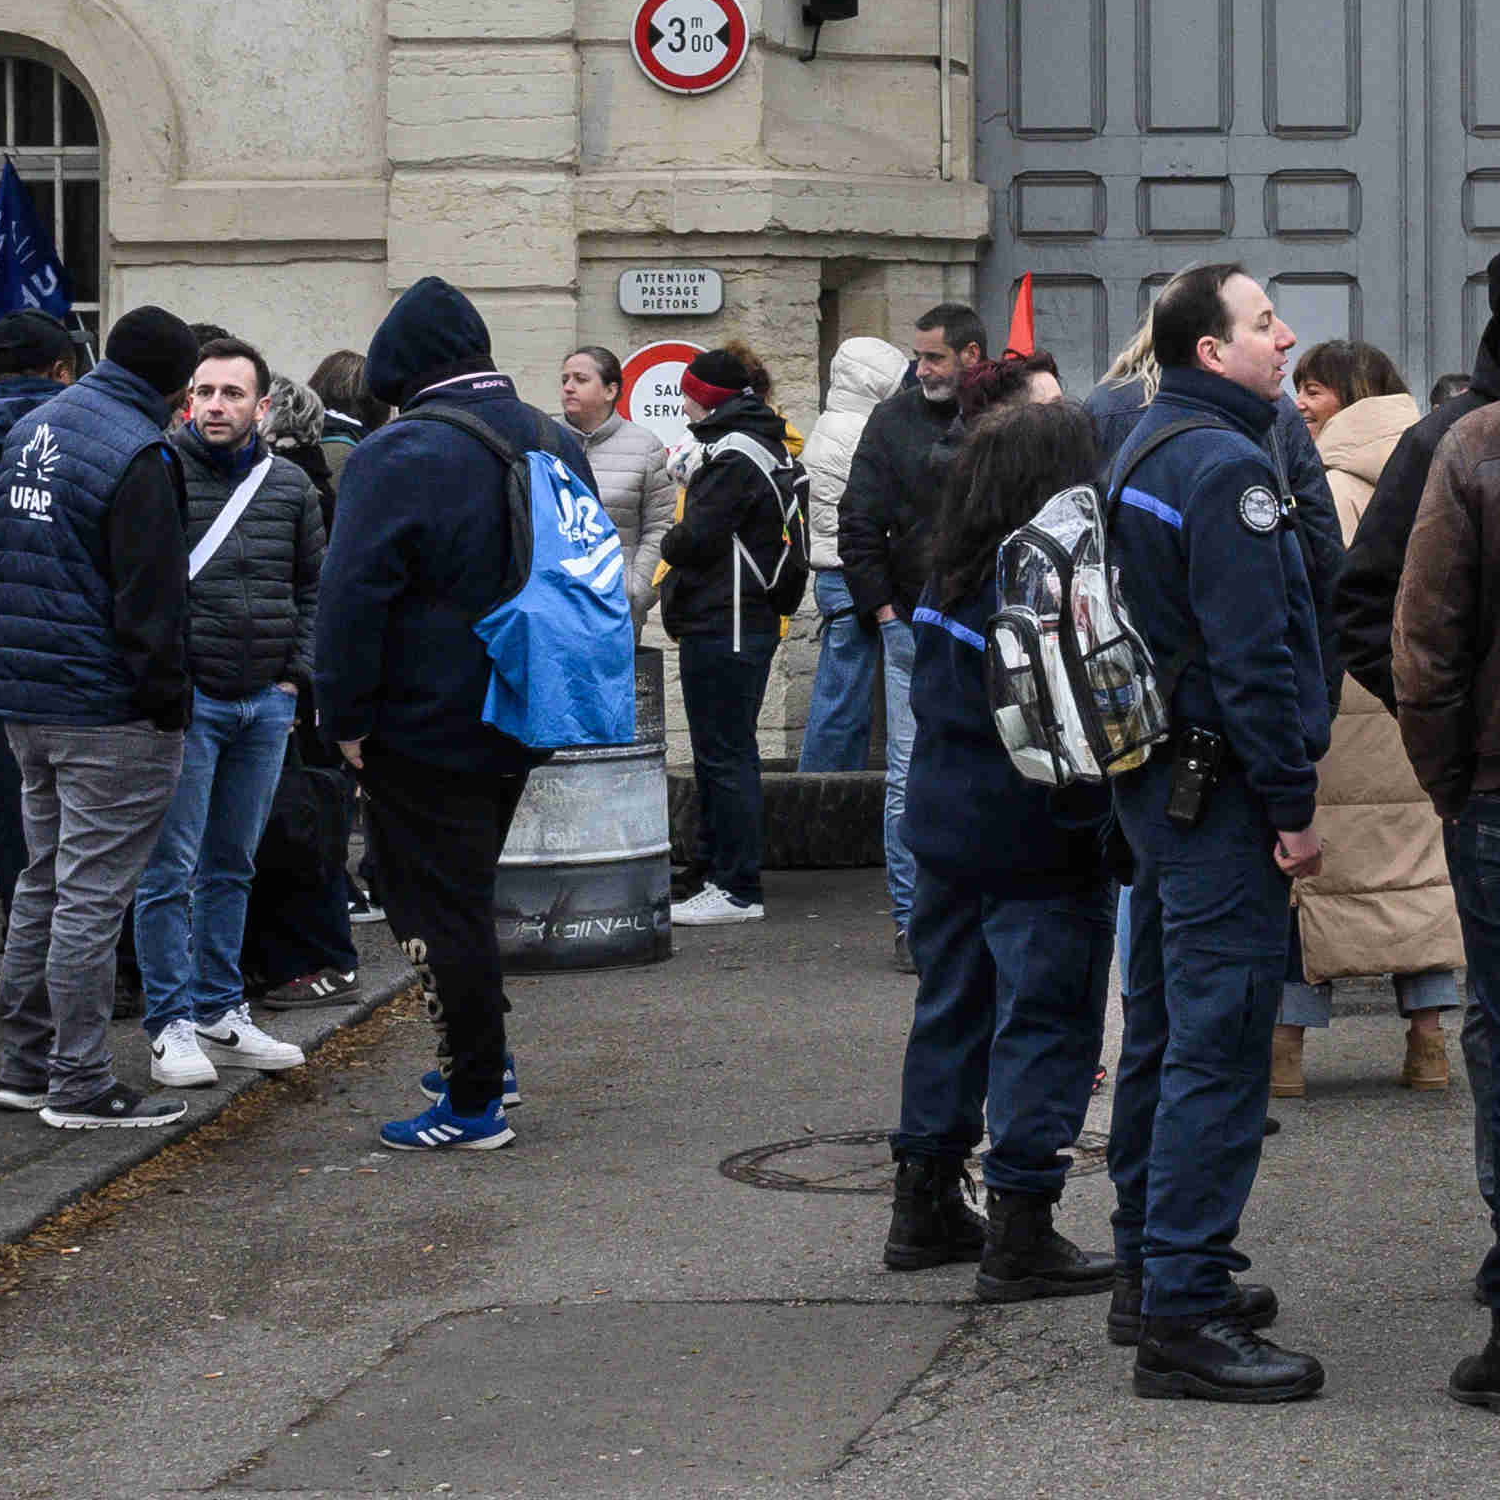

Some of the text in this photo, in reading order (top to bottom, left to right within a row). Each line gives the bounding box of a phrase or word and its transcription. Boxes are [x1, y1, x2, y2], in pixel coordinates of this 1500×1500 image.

[667, 17, 686, 52] 3
[691, 35, 713, 52] 00
[635, 274, 706, 284] ATTENTION
[641, 286, 700, 296] PASSAGE
[642, 298, 699, 309] PIÉTONS
[654, 384, 682, 397] SAU
[10, 485, 52, 513] UFAP
